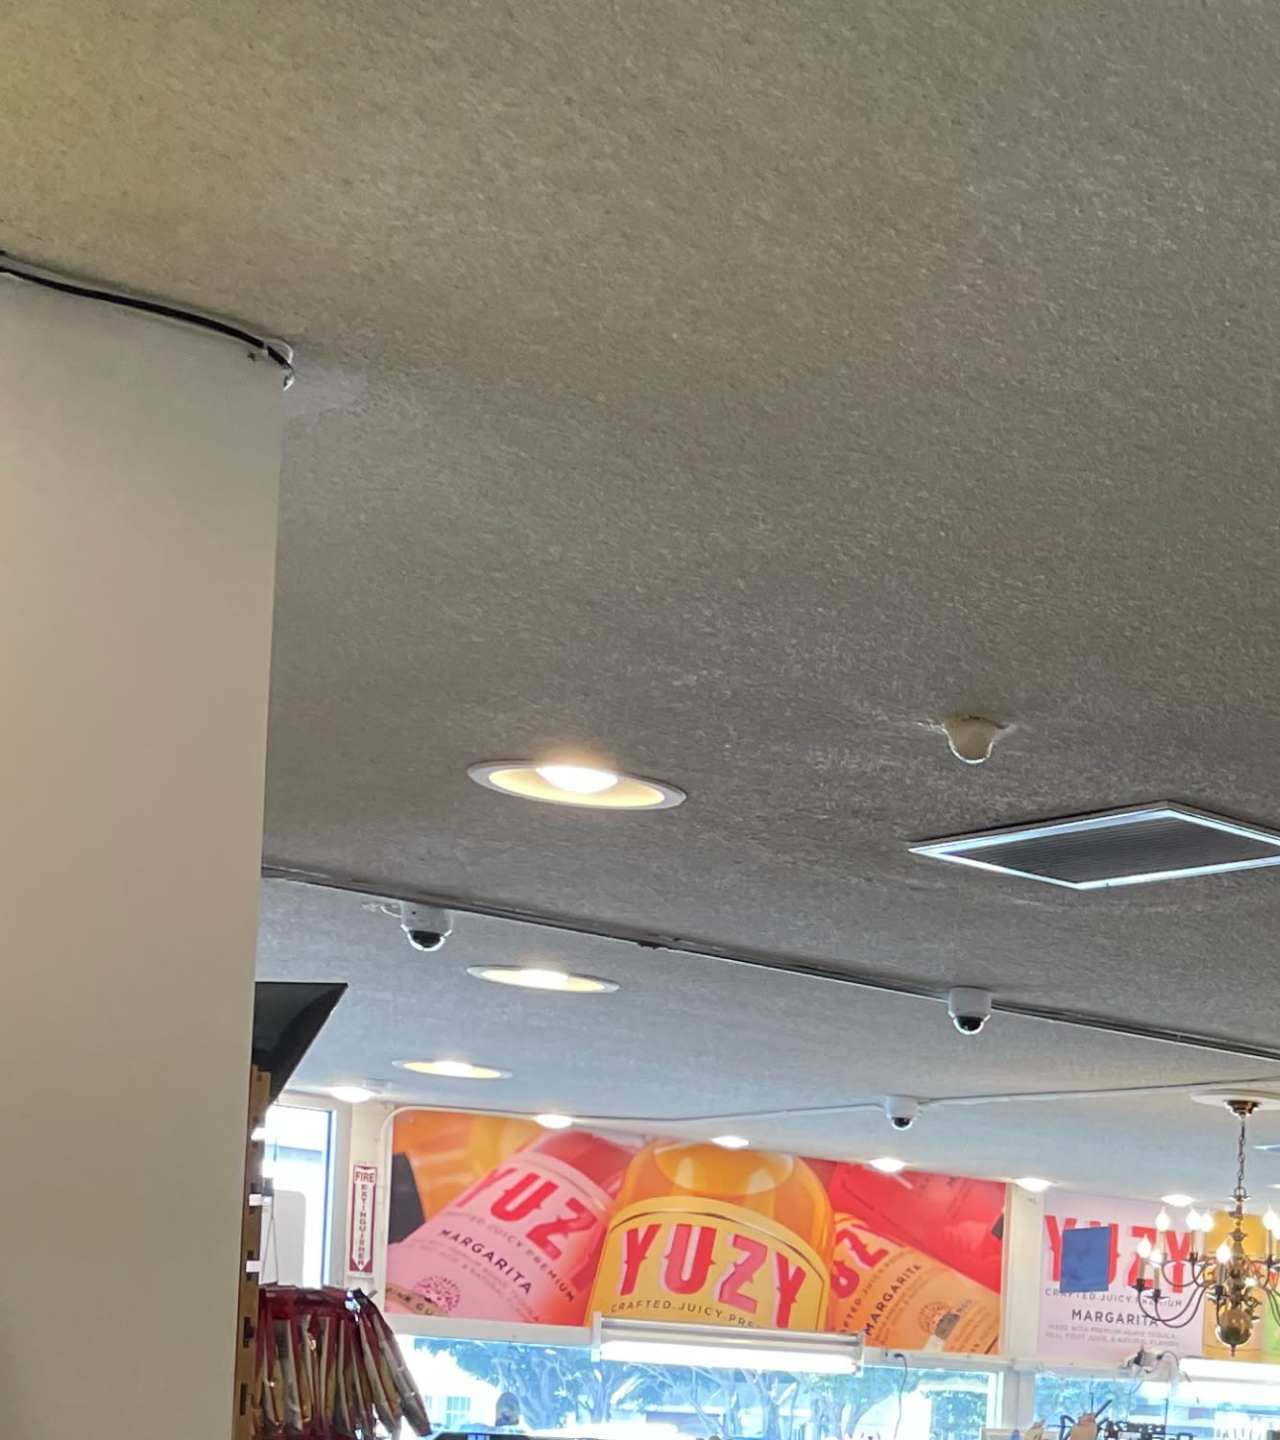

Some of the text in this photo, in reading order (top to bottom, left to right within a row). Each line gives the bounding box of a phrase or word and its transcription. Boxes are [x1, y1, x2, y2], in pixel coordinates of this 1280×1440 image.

[440, 1229, 532, 1295] MARGARITA
[620, 1223, 807, 1328] YUZY
[610, 1300, 724, 1320] CRAFTED JUICY
[1071, 1308, 1160, 1327] MARGARITA
